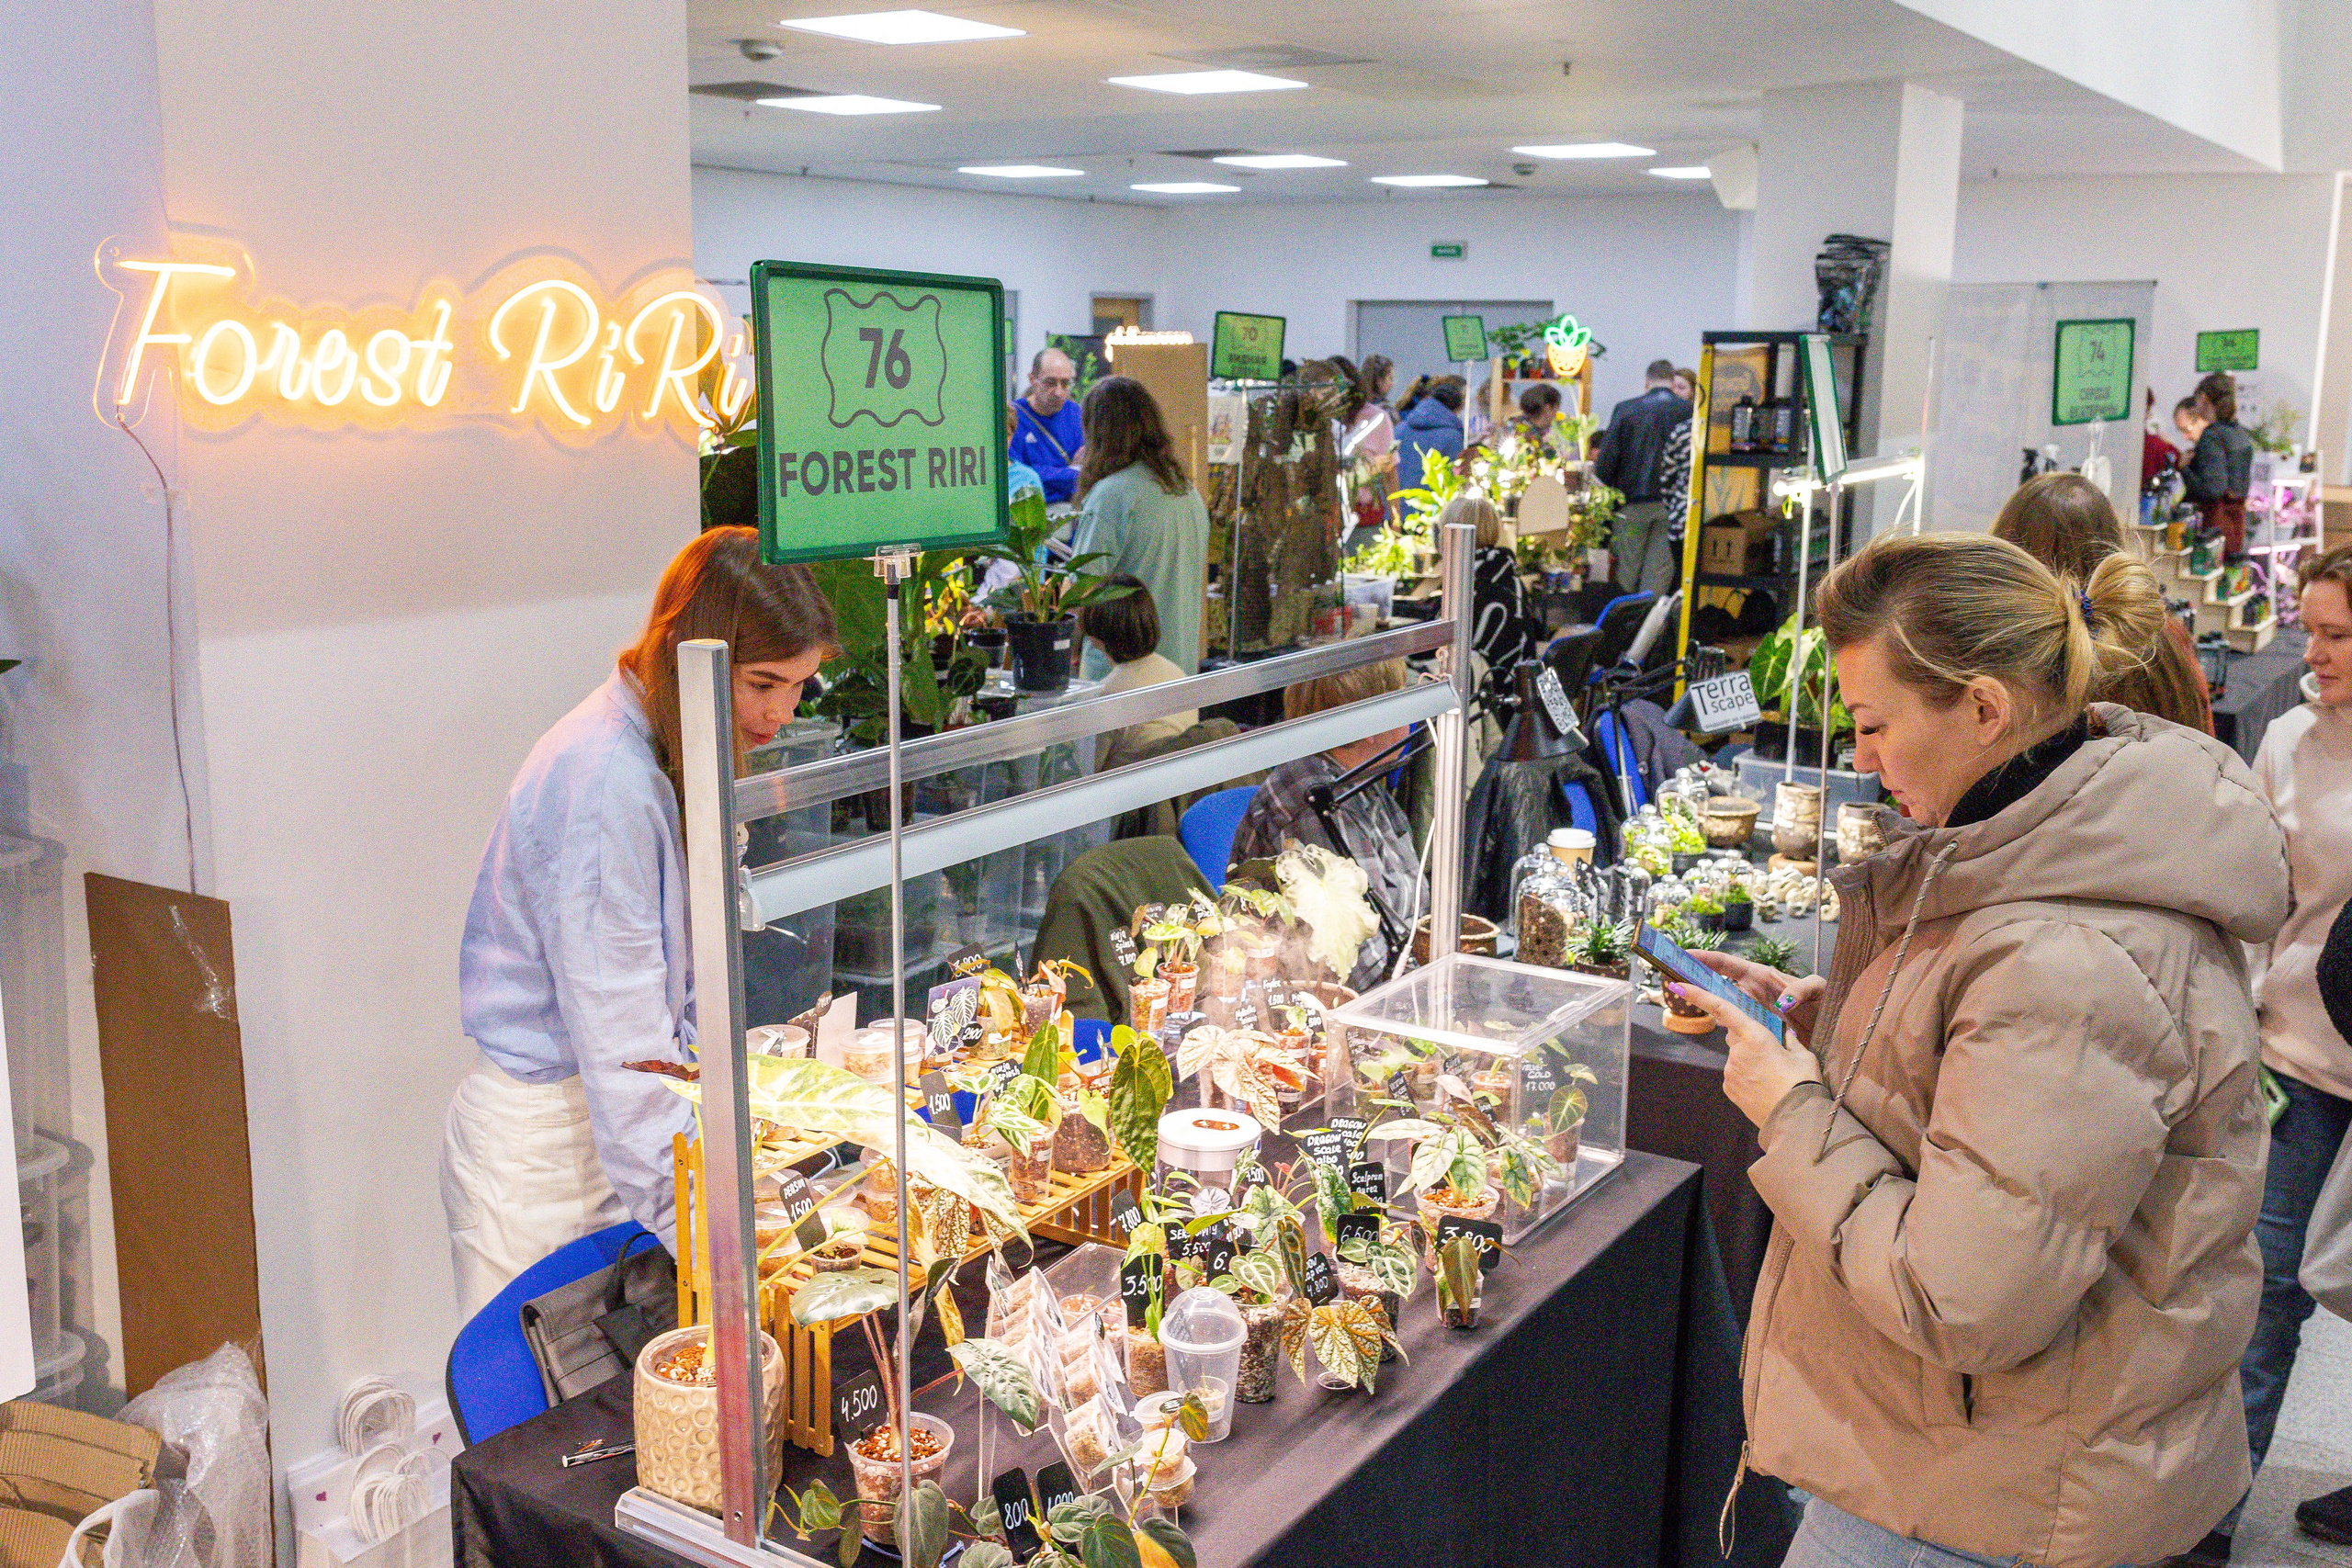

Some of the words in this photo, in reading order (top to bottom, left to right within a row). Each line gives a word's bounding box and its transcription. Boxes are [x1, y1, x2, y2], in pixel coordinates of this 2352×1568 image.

[119, 259, 454, 407] Forest
[489, 278, 748, 428] RiRi
[1241, 326, 1259, 342] 70
[2090, 340, 2107, 363] 74
[858, 327, 912, 390] 76
[779, 447, 917, 498] FOREST
[928, 446, 987, 489] RIRI
[1691, 674, 1750, 716] Terra
[1711, 692, 1755, 714] scape
[841, 1384, 877, 1423] 4.500
[1004, 1497, 1030, 1530] 800
